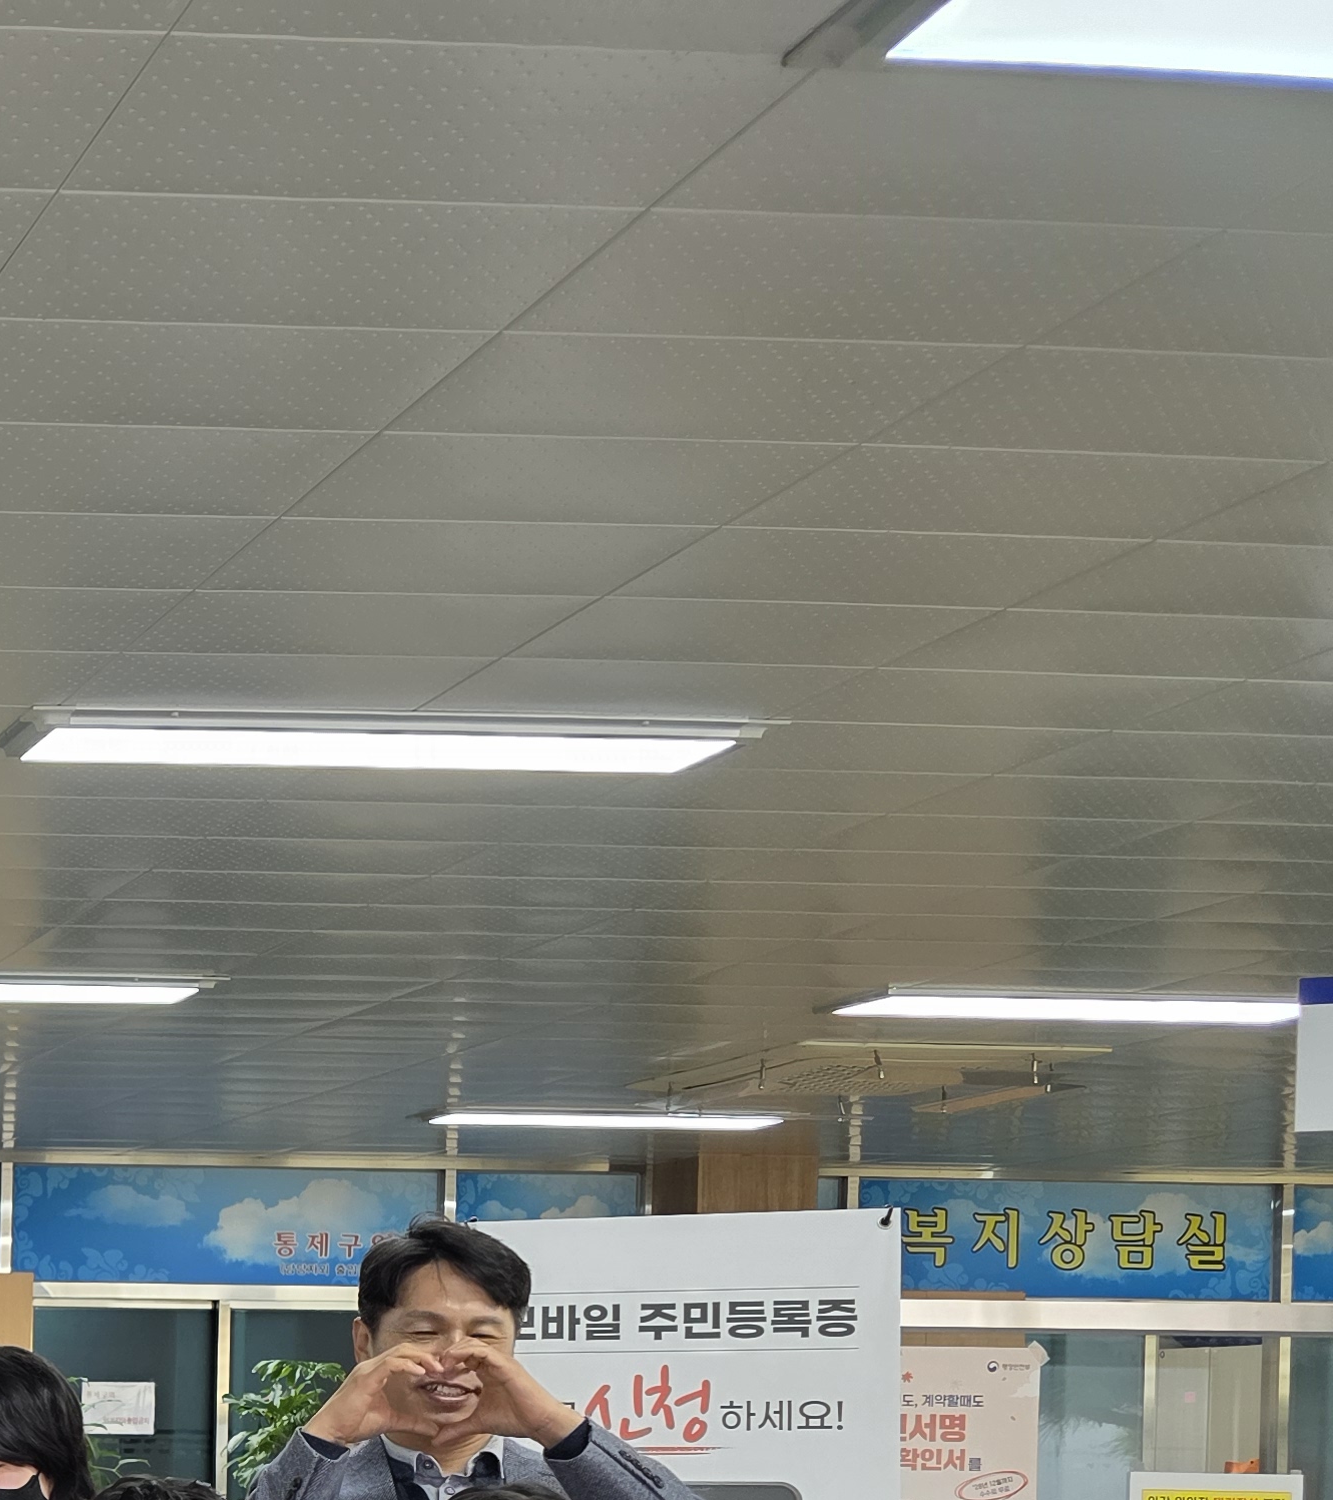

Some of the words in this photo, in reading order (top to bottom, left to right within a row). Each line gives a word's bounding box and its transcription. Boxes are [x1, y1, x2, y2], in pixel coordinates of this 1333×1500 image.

[274, 1231, 394, 1259] 통제구
[901, 1207, 1226, 1270] 복지상담실
[638, 1299, 857, 1340] 주민등록증
[585, 1364, 711, 1443] 신청
[720, 1401, 843, 1432] 하세요!
[922, 1394, 984, 1408] 계약할때도
